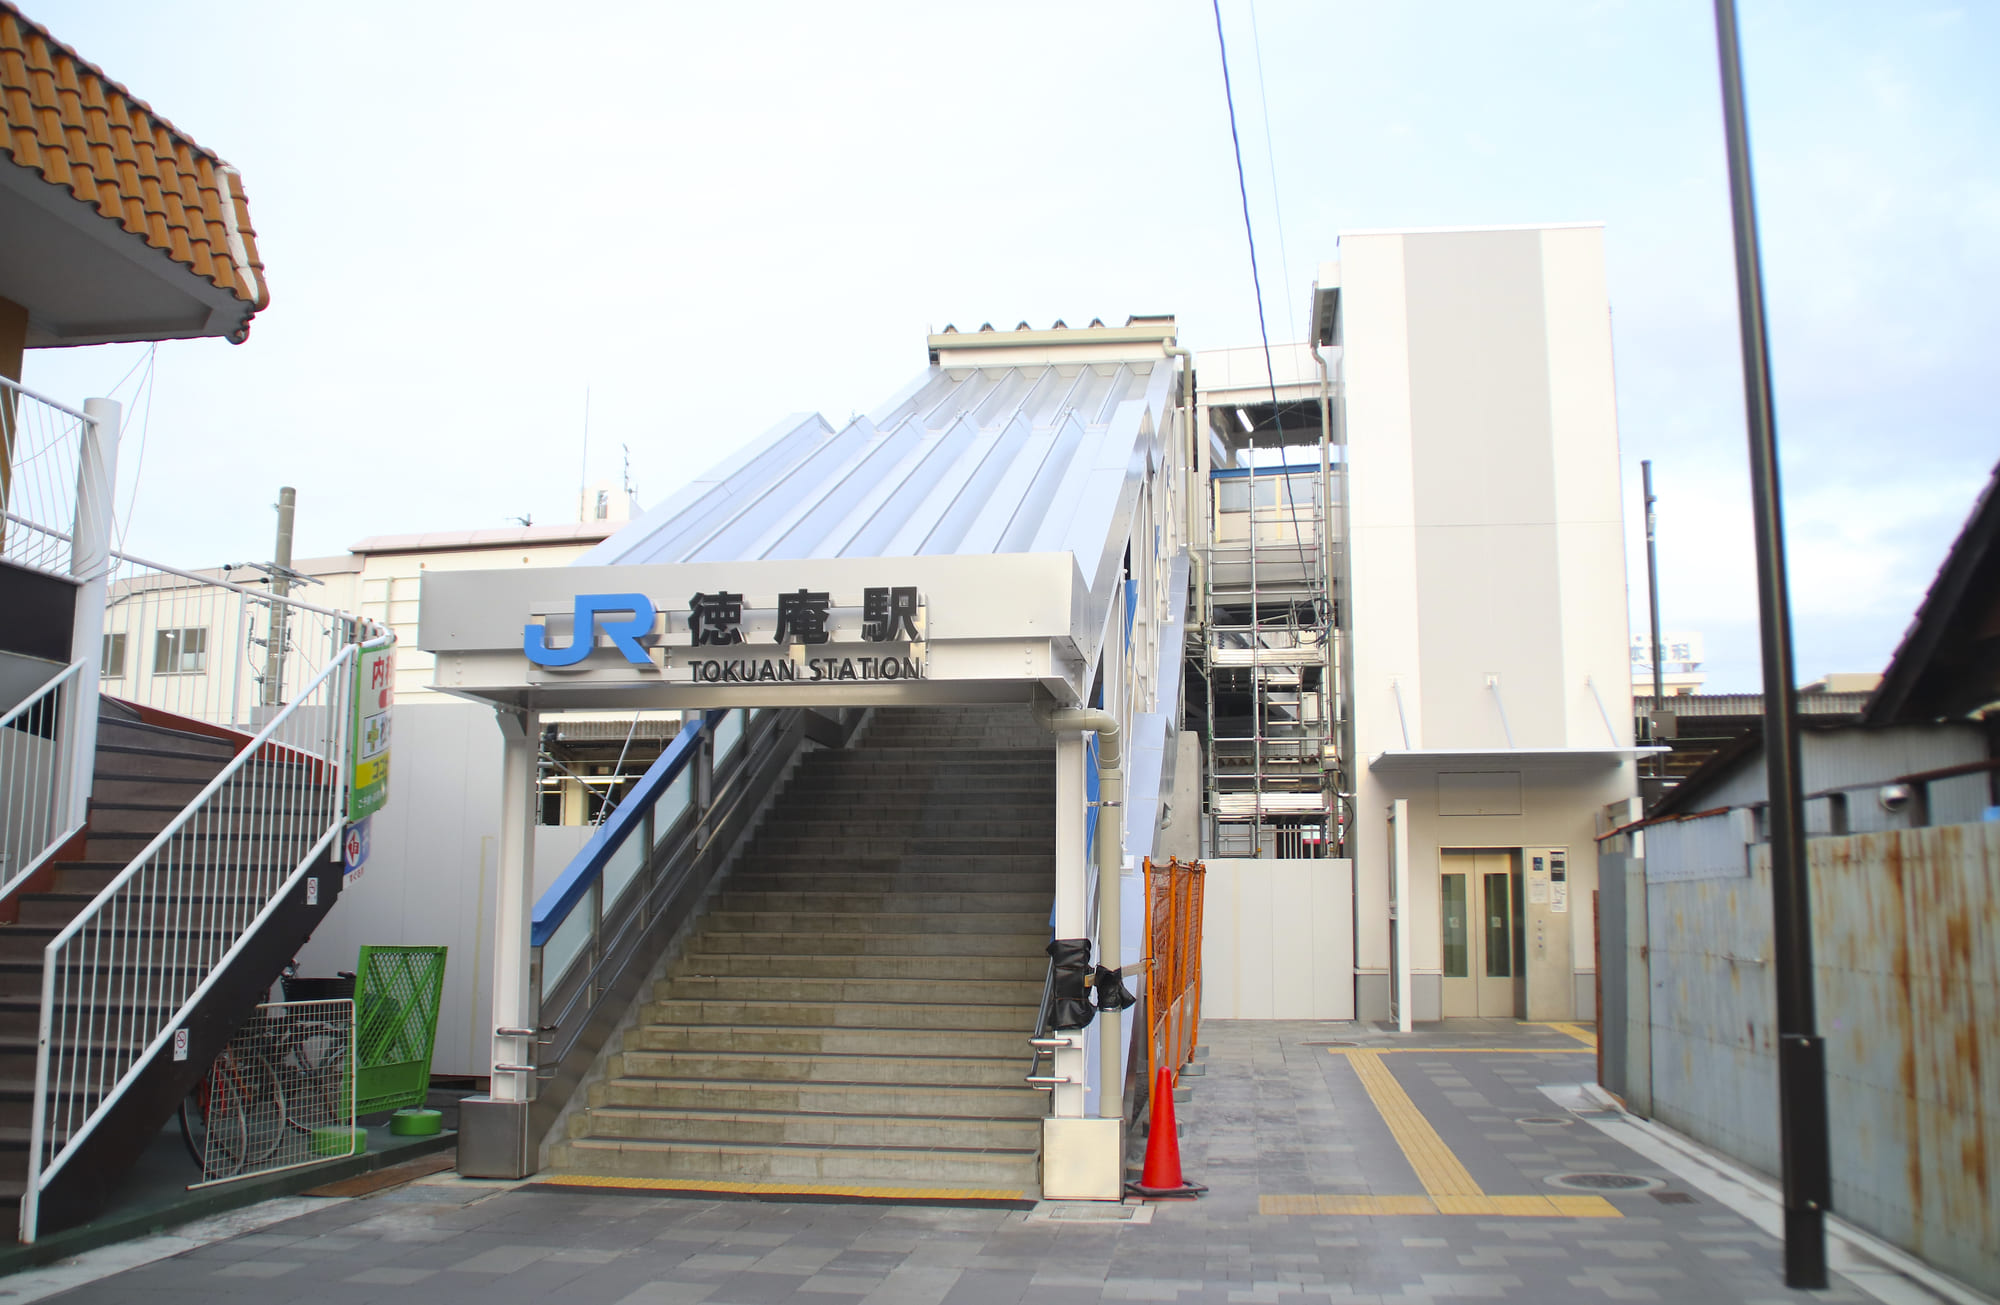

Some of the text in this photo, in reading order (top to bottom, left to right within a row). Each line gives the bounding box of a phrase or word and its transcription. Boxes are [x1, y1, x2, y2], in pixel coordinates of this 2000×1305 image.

[524, 593, 655, 666] JR
[688, 587, 919, 647] 徳庵駅
[688, 657, 920, 682] TOKUAN STATION
